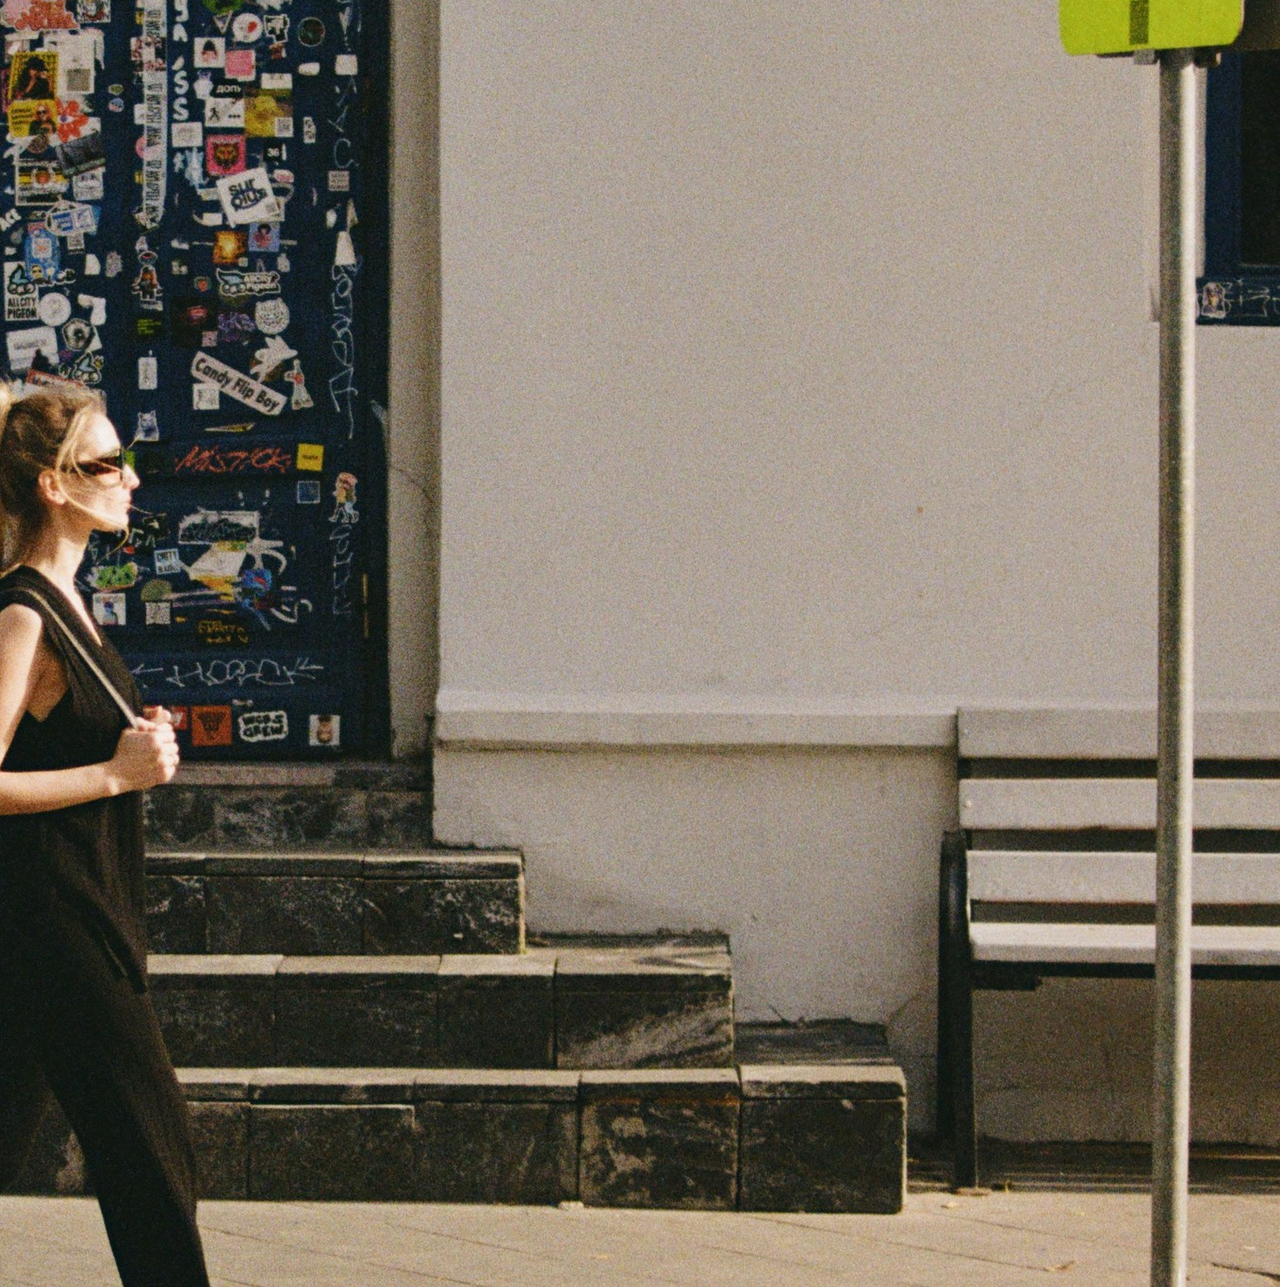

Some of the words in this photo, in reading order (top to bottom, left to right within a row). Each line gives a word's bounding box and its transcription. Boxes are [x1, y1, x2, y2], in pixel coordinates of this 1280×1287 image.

[7, 308, 37, 319] PIGEON
[195, 358, 232, 388] Candy
[232, 375, 255, 399] Flip
[256, 389, 280, 412] Boy
